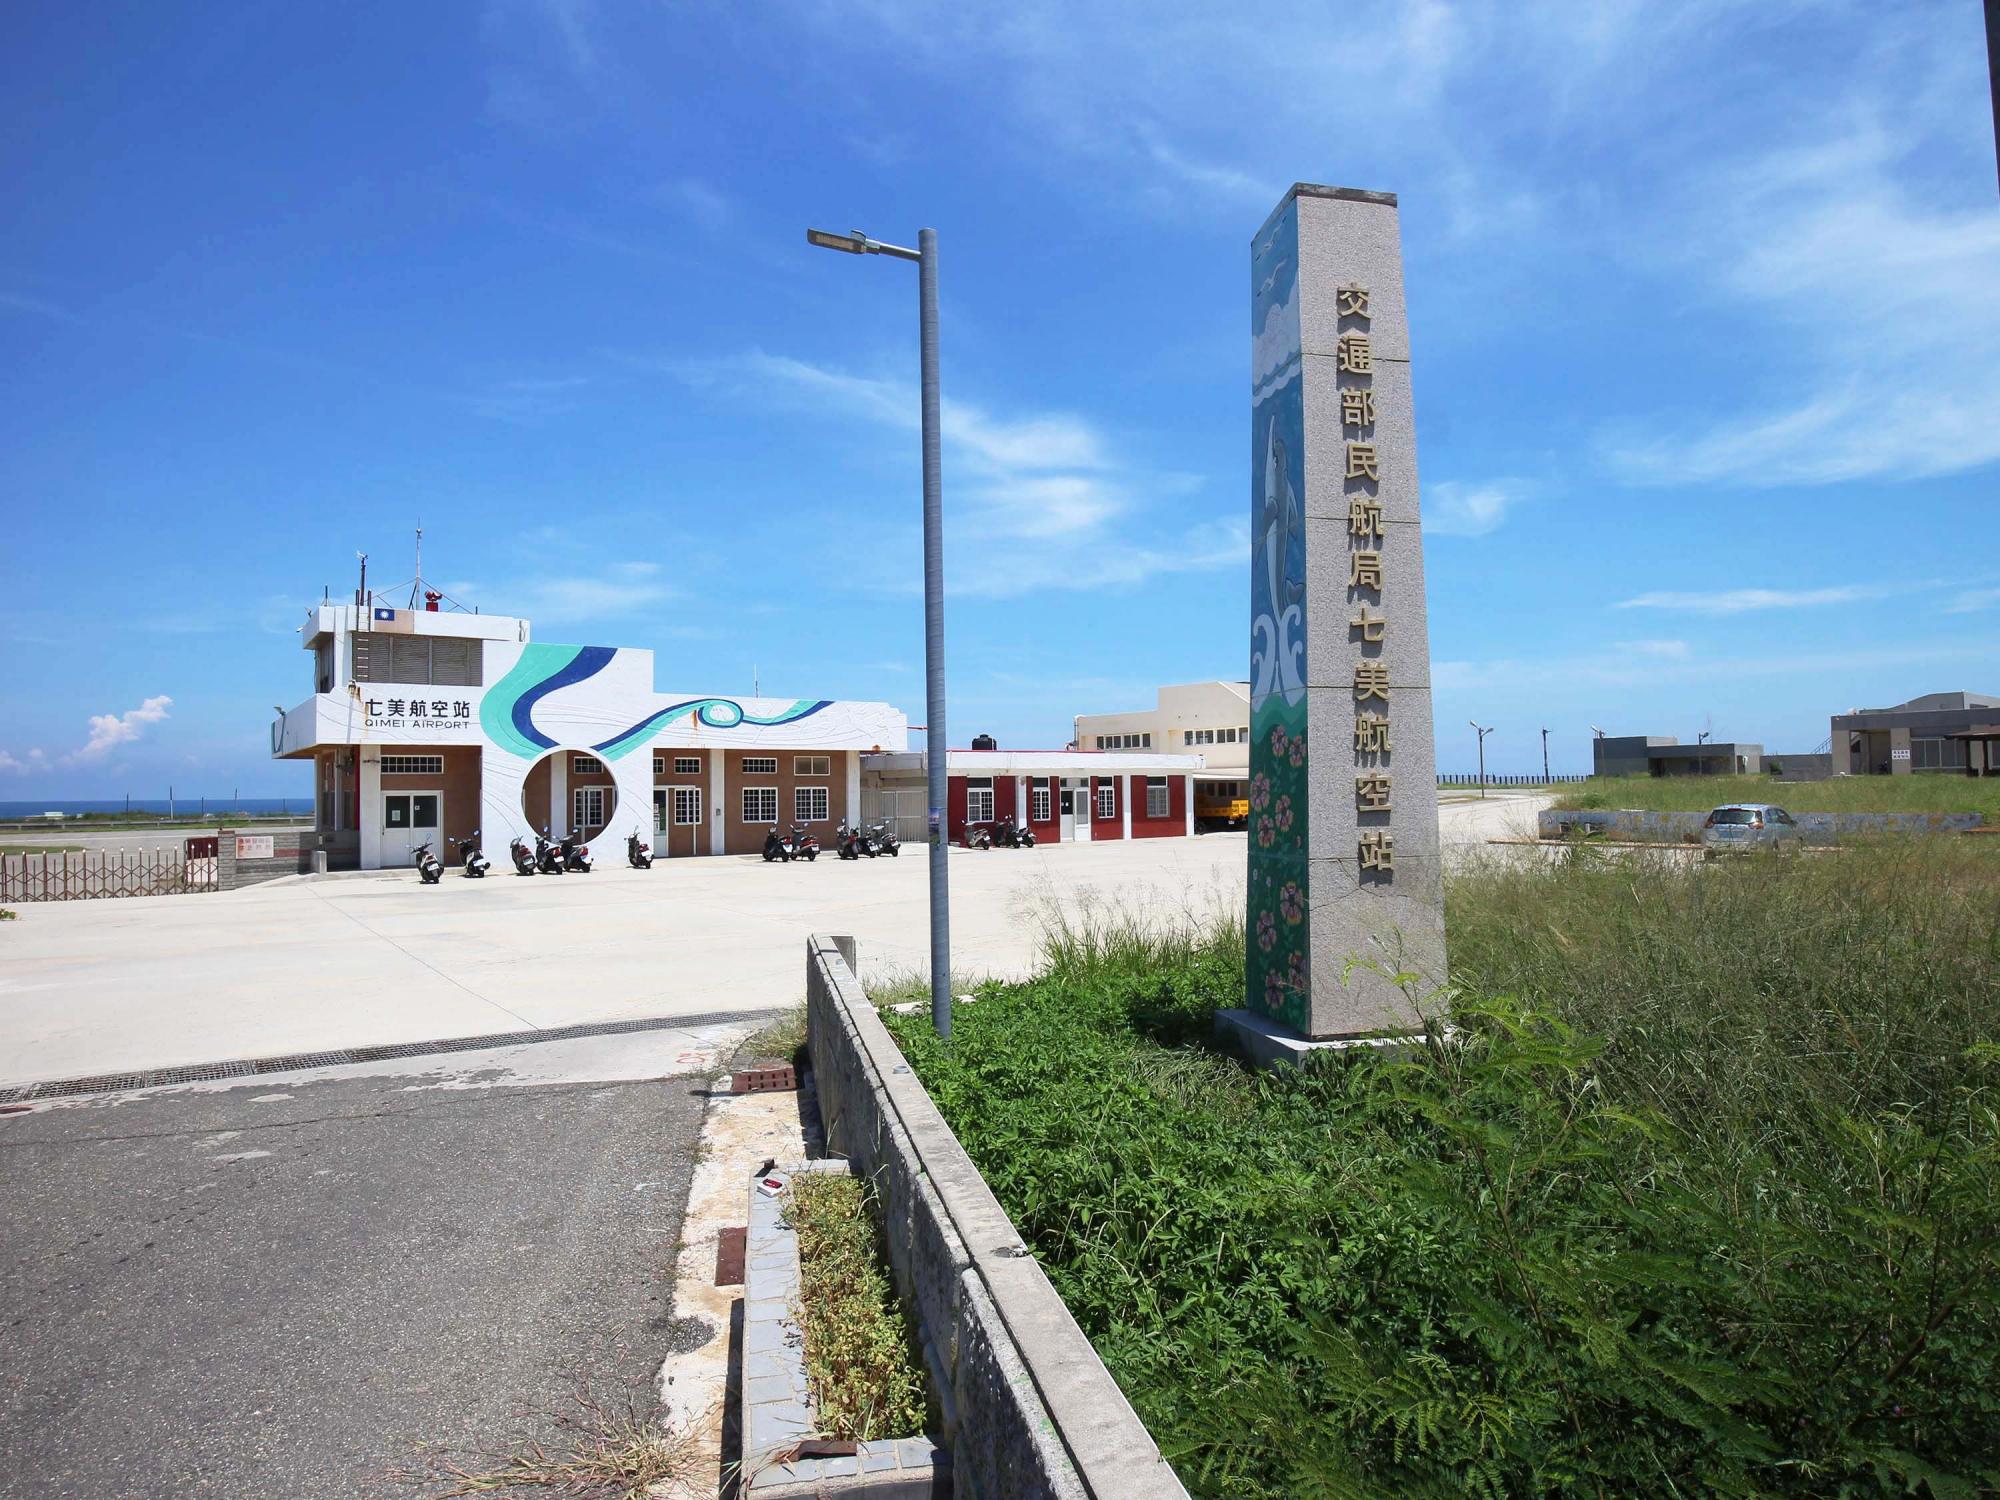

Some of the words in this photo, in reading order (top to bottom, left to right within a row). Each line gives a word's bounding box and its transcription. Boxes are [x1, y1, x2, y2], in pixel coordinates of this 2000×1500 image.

[1336, 282, 1393, 871] 交通部民航局七美航空站
[365, 698, 471, 718] 七美航空站
[365, 719, 405, 728] QIMEI
[412, 720, 470, 729] AIRPORT
